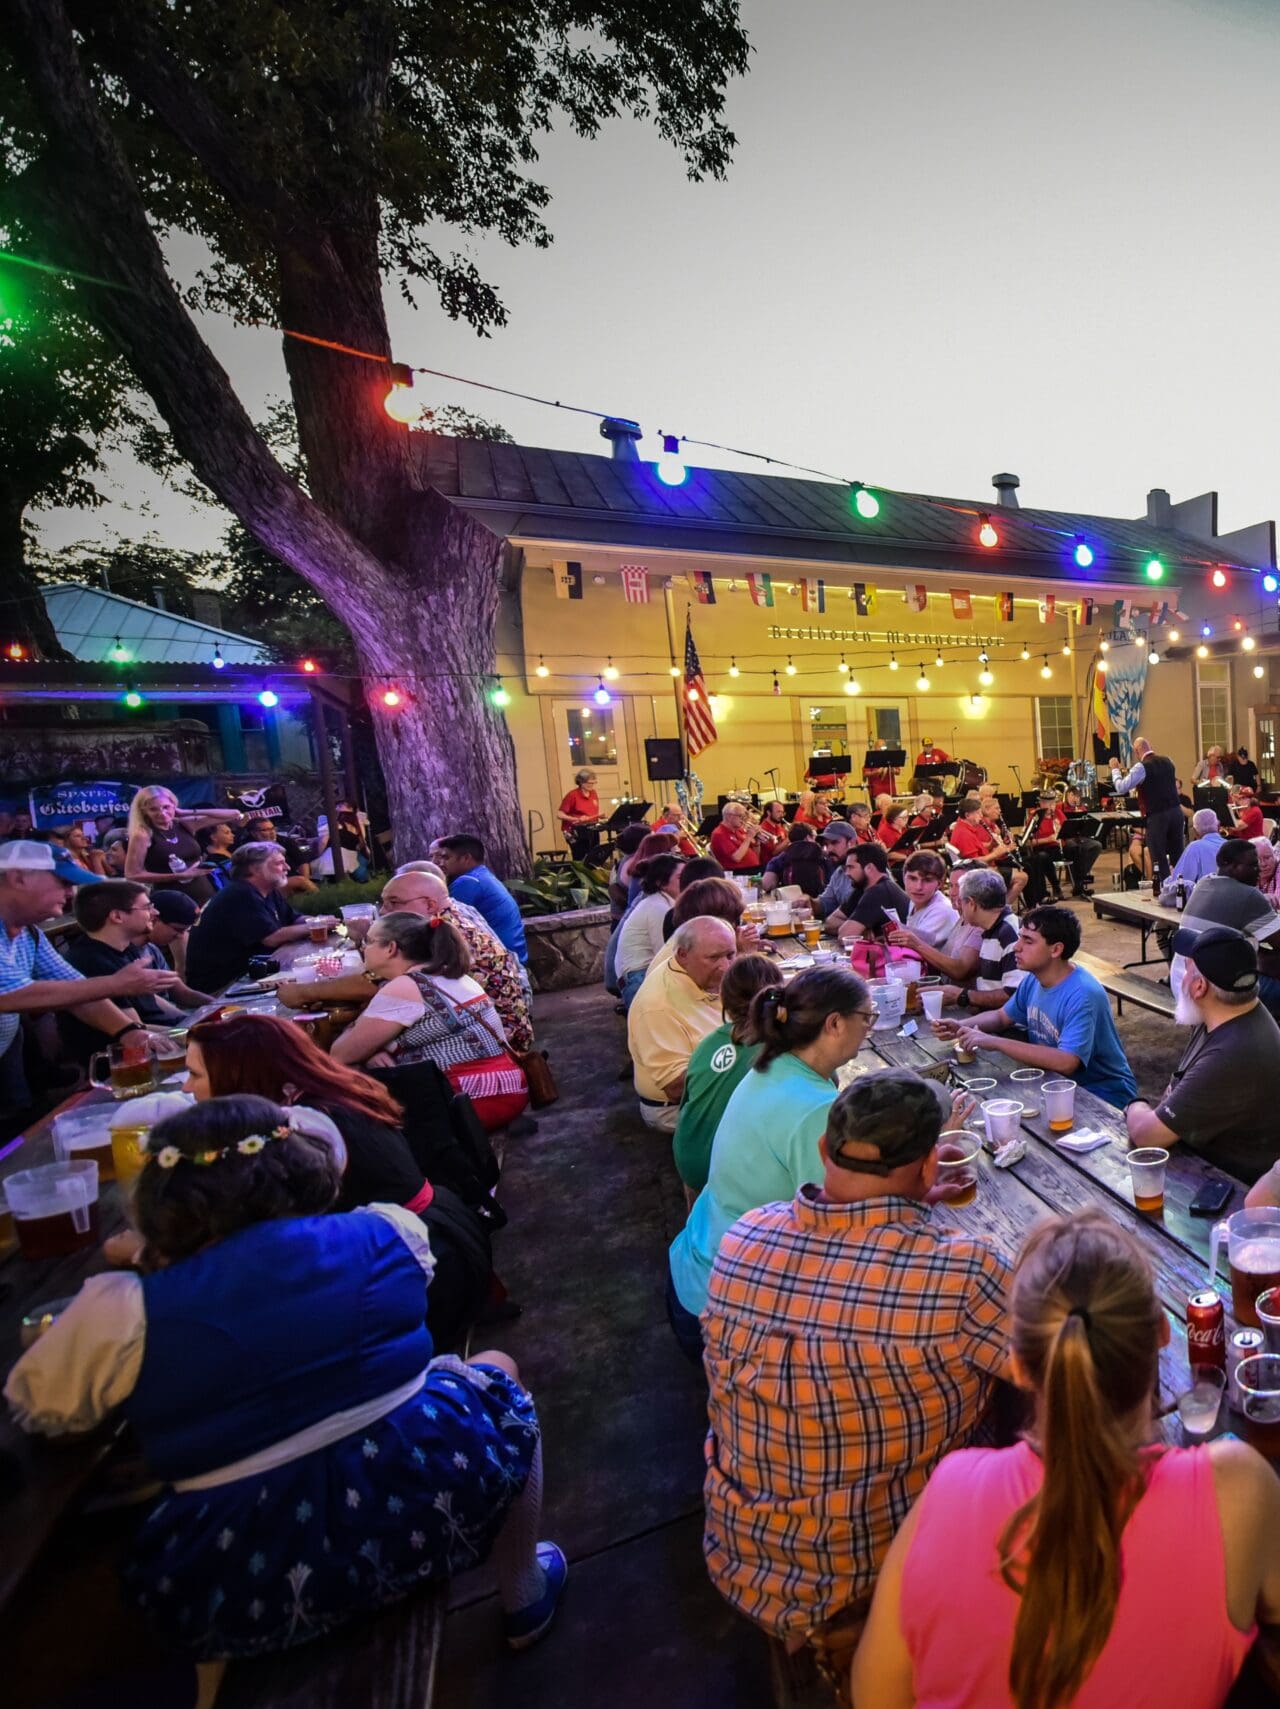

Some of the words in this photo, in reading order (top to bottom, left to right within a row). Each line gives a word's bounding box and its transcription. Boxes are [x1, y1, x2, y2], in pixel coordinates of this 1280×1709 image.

[772, 625, 871, 642] Beethoven
[57, 790, 117, 798] SPATEN
[39, 800, 130, 815] Oktoberfes
